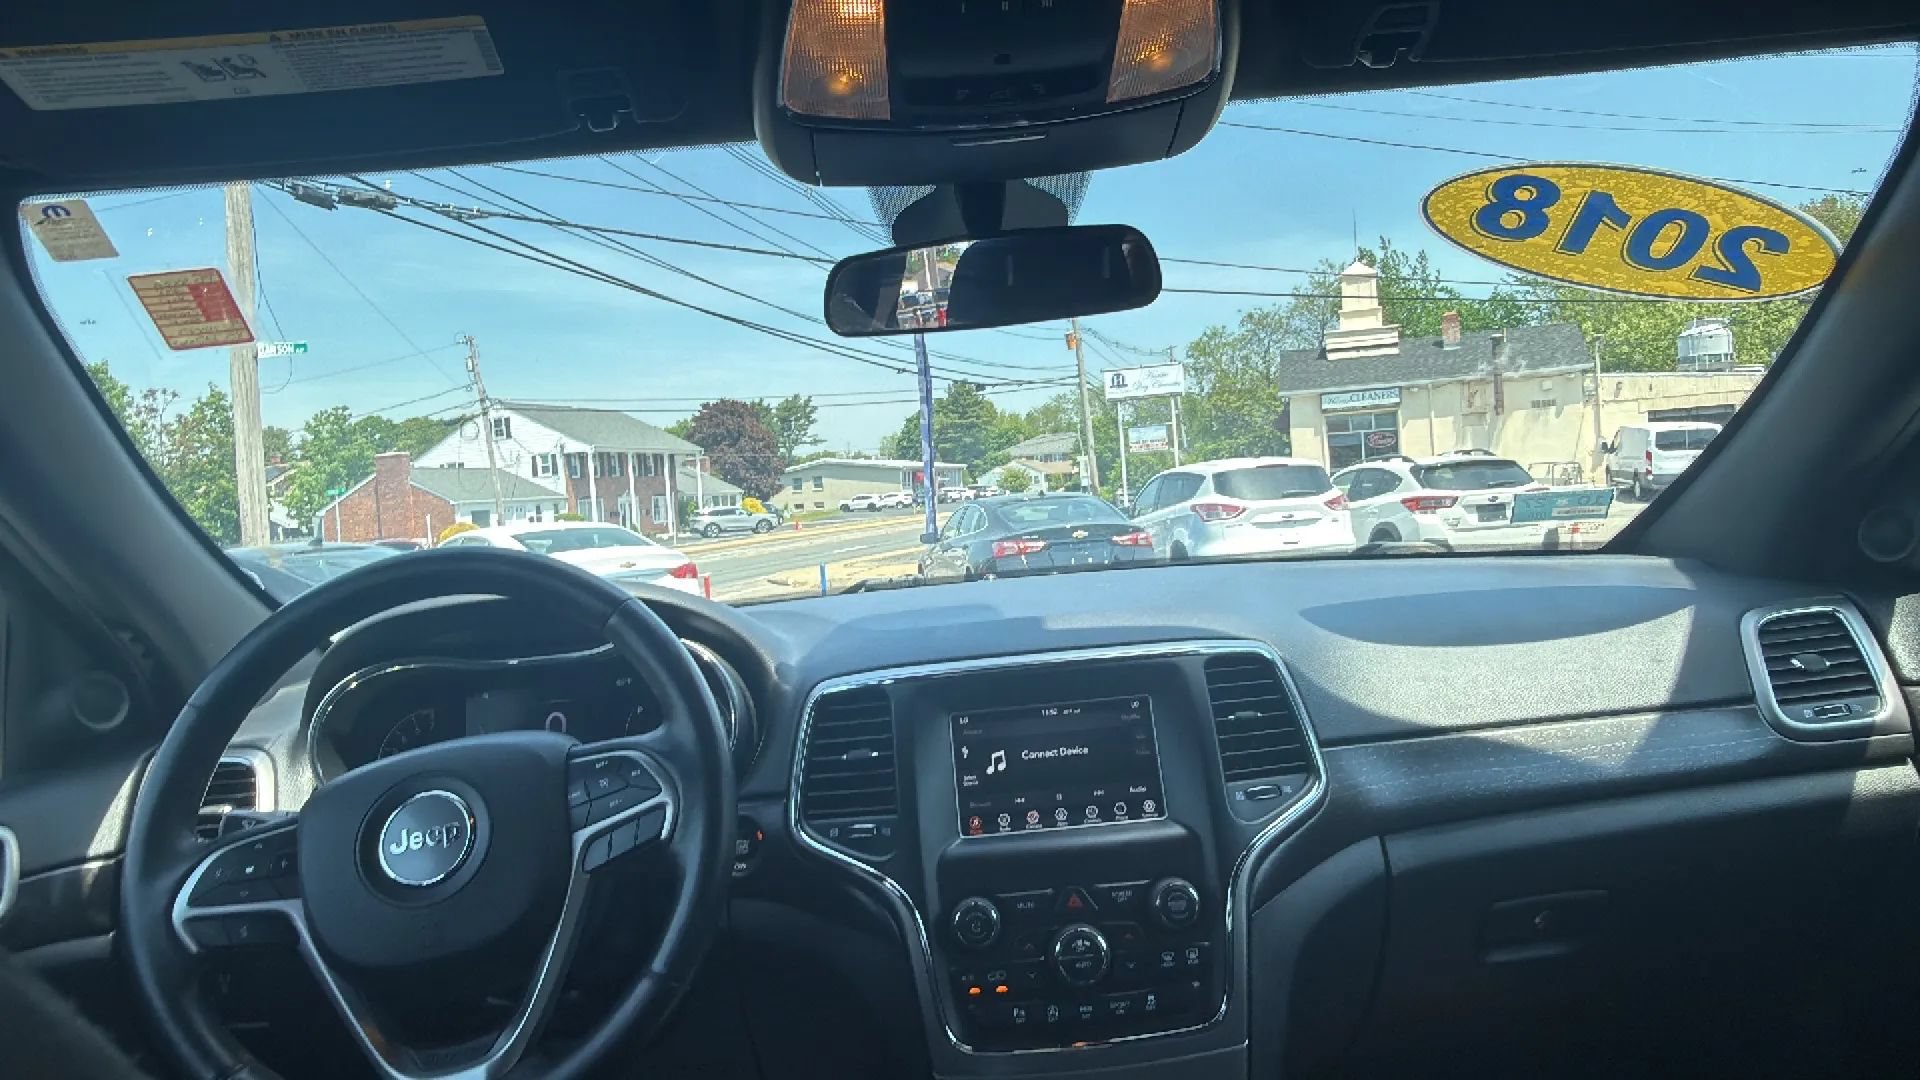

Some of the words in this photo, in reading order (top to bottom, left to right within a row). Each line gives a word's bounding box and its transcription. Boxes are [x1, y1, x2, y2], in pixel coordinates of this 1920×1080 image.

[1349, 387, 1399, 402] CLEANERS
[1021, 748, 1059, 760] Connect
[1060, 745, 1089, 757] Device
[1129, 785, 1147, 793] Audio
[389, 820, 461, 856] Jeep
